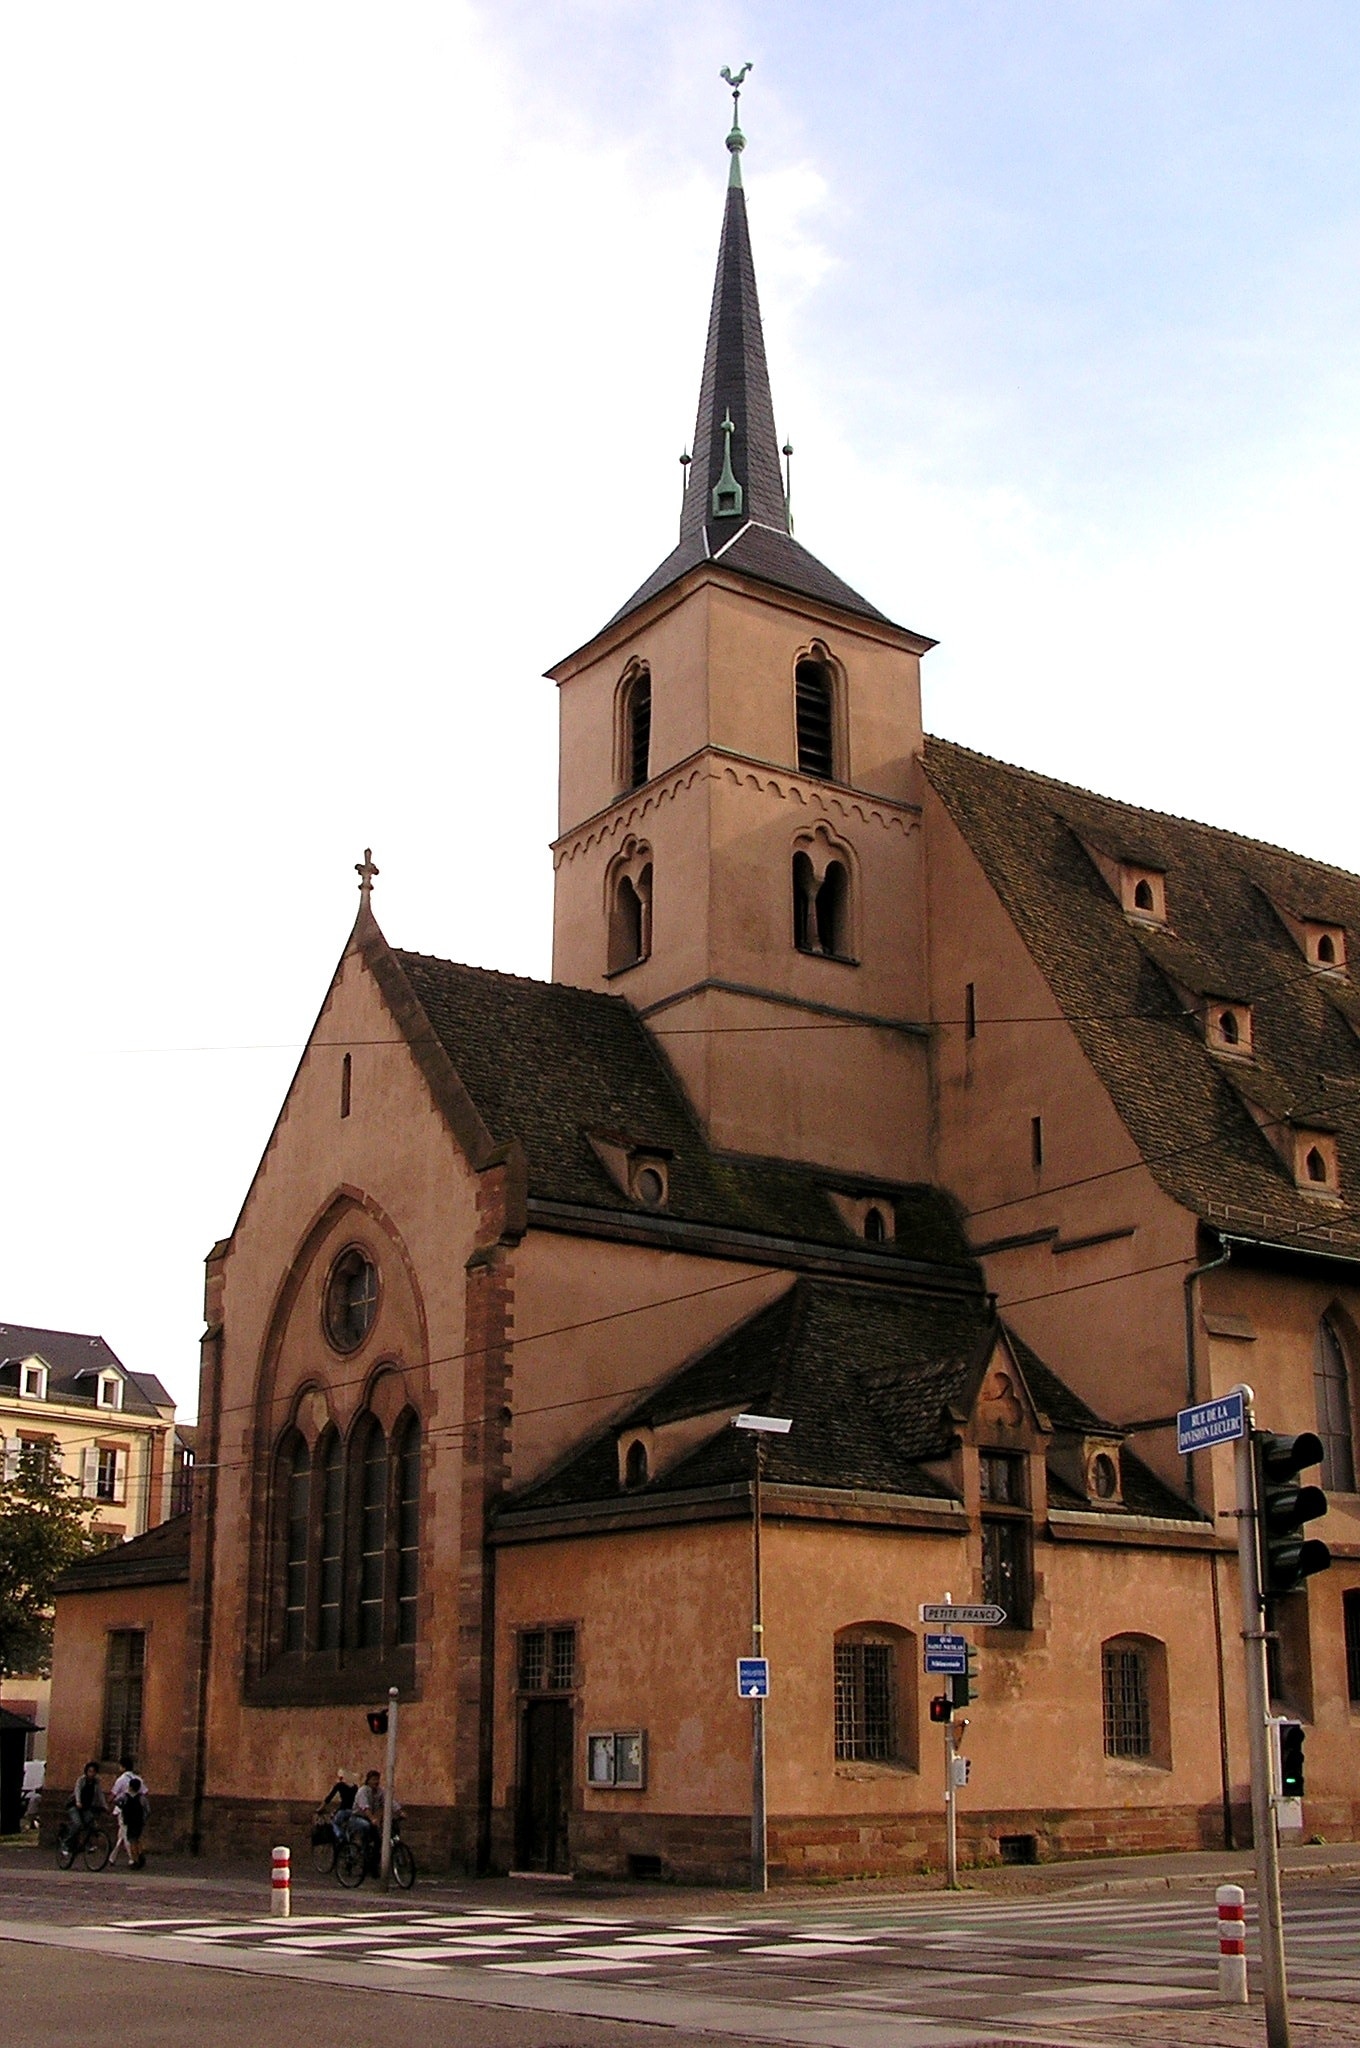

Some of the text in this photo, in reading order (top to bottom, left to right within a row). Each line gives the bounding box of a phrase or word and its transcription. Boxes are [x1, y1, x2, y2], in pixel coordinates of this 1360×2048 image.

[1191, 1405, 1228, 1427] RUE DE LA
[1180, 1416, 1241, 1446] DIVISION LECLERC
[928, 1609, 996, 1619] PETITE FRANCE
